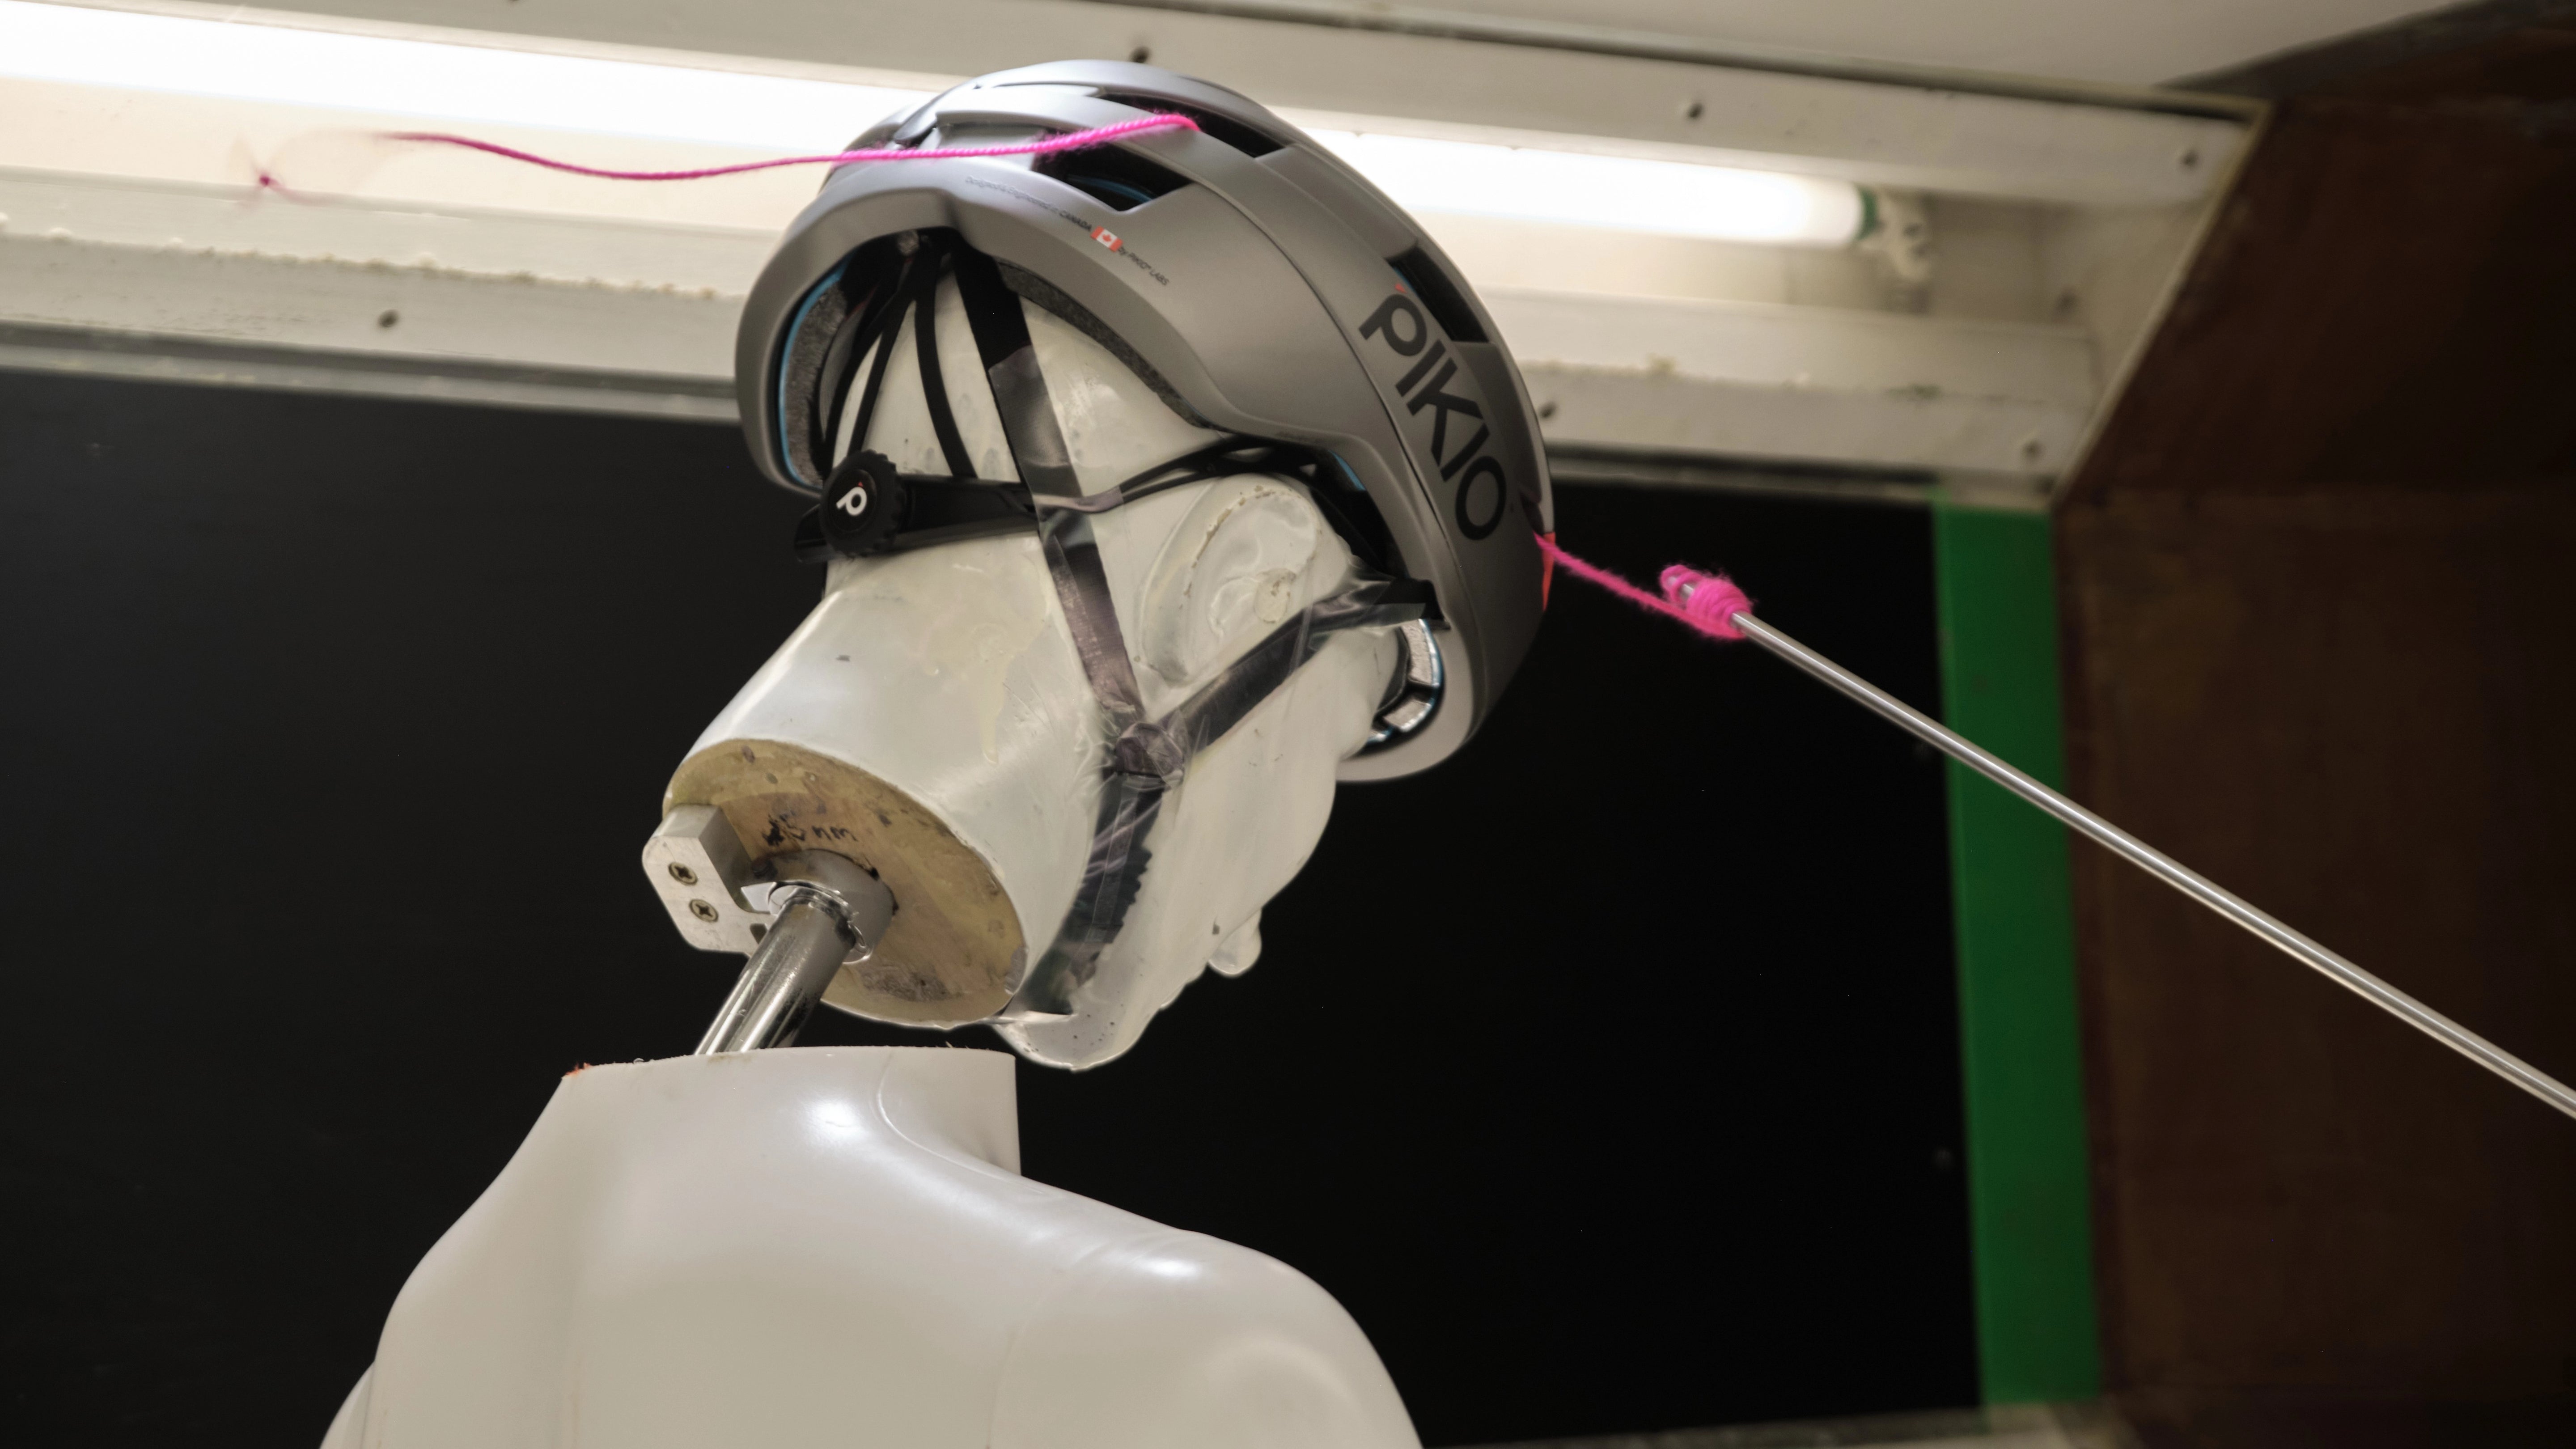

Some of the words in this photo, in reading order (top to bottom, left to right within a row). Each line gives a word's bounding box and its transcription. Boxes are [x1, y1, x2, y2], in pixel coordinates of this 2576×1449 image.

[1059, 210, 1092, 232] CANADA
[1118, 246, 1128, 256] by
[1149, 270, 1169, 285] LABS
[1358, 293, 1506, 540] PIKIO
